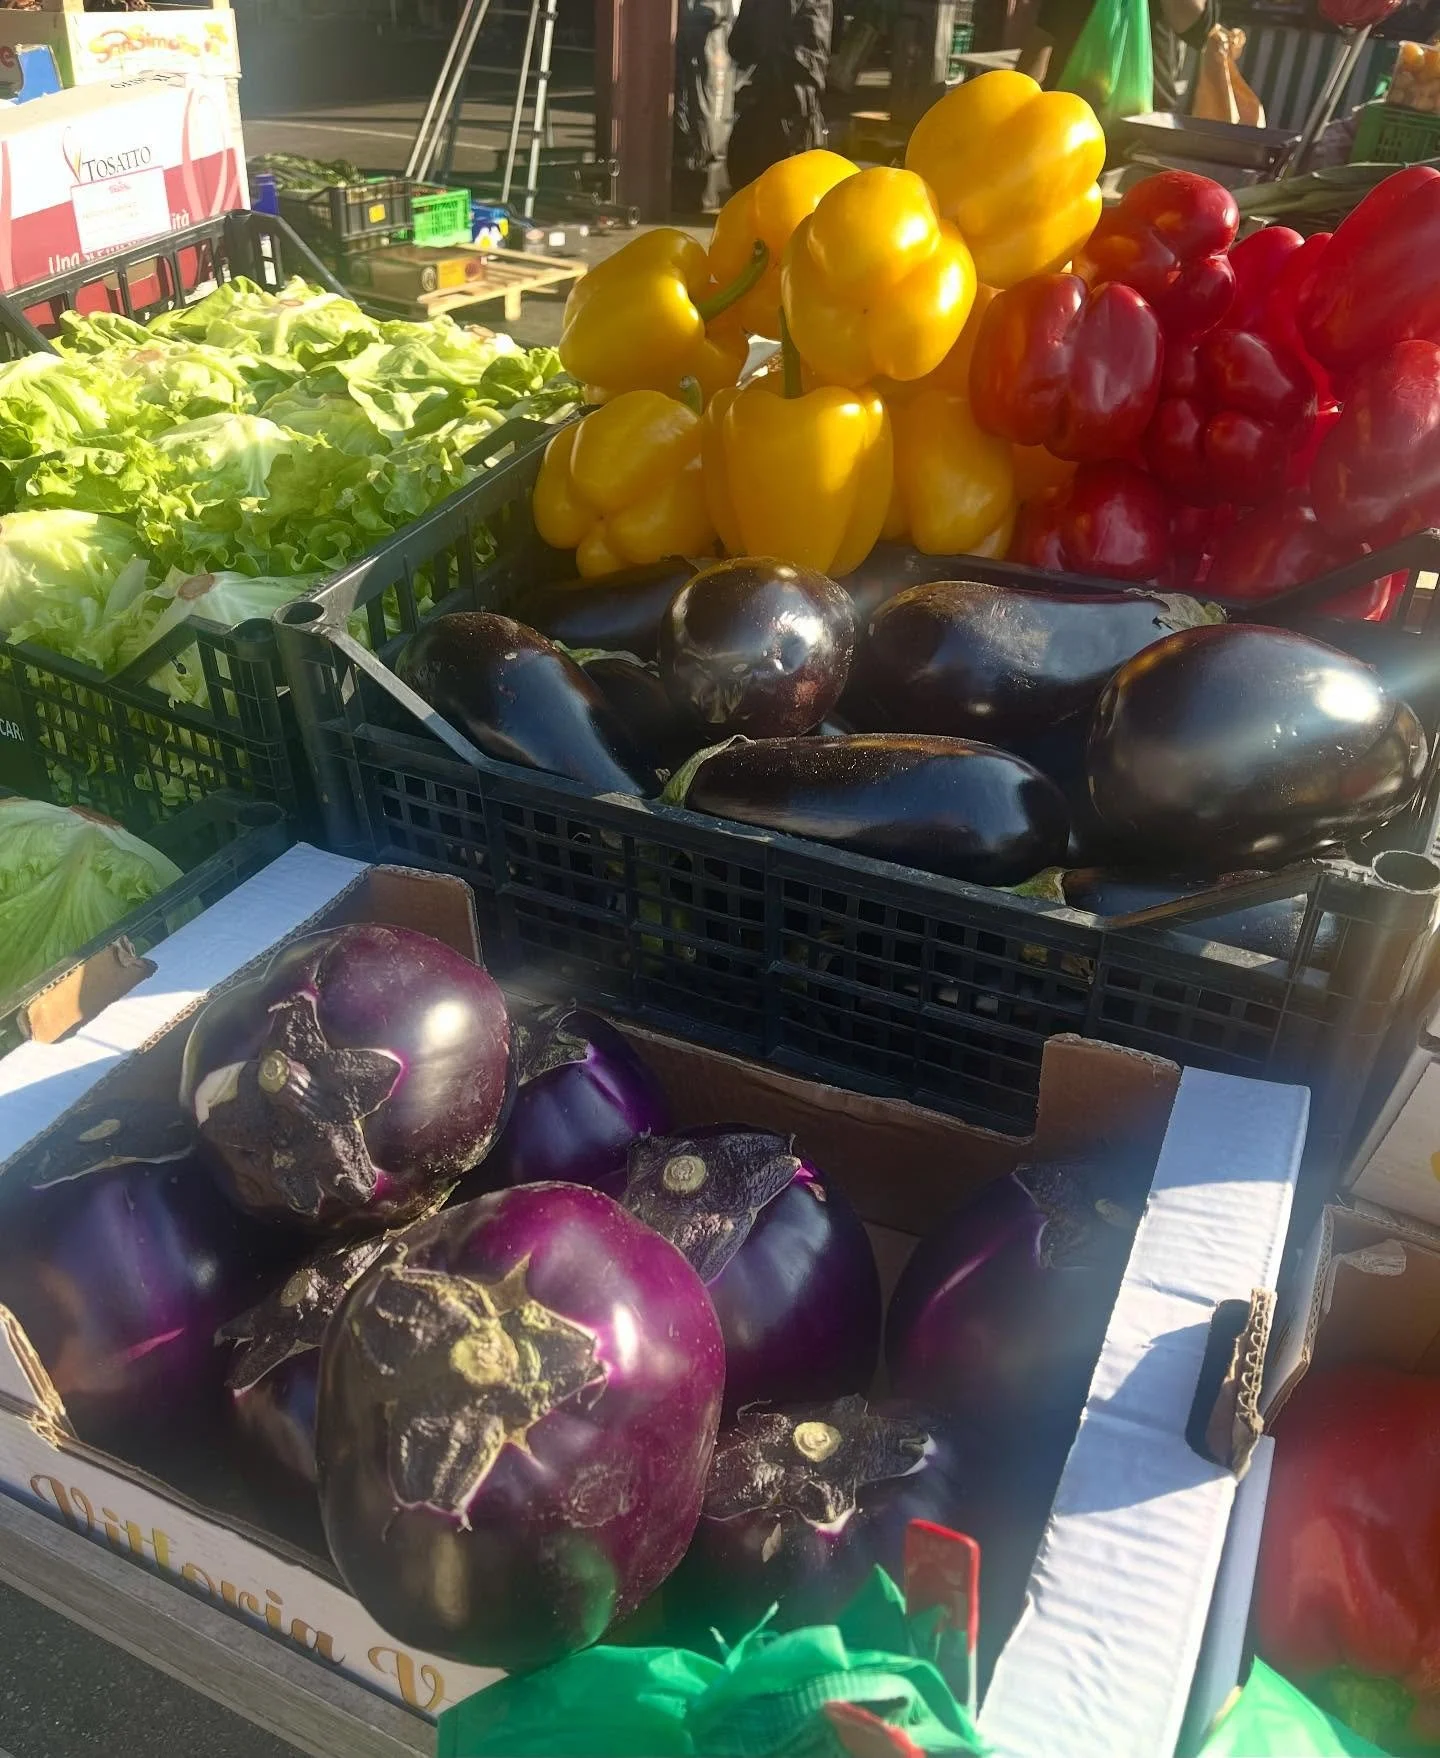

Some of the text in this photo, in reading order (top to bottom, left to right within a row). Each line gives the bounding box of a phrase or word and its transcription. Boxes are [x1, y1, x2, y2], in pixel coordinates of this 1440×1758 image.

[81, 145, 152, 182] TOSATTO
[48, 208, 190, 274] Una ità
[367, 1646, 446, 1712] V
